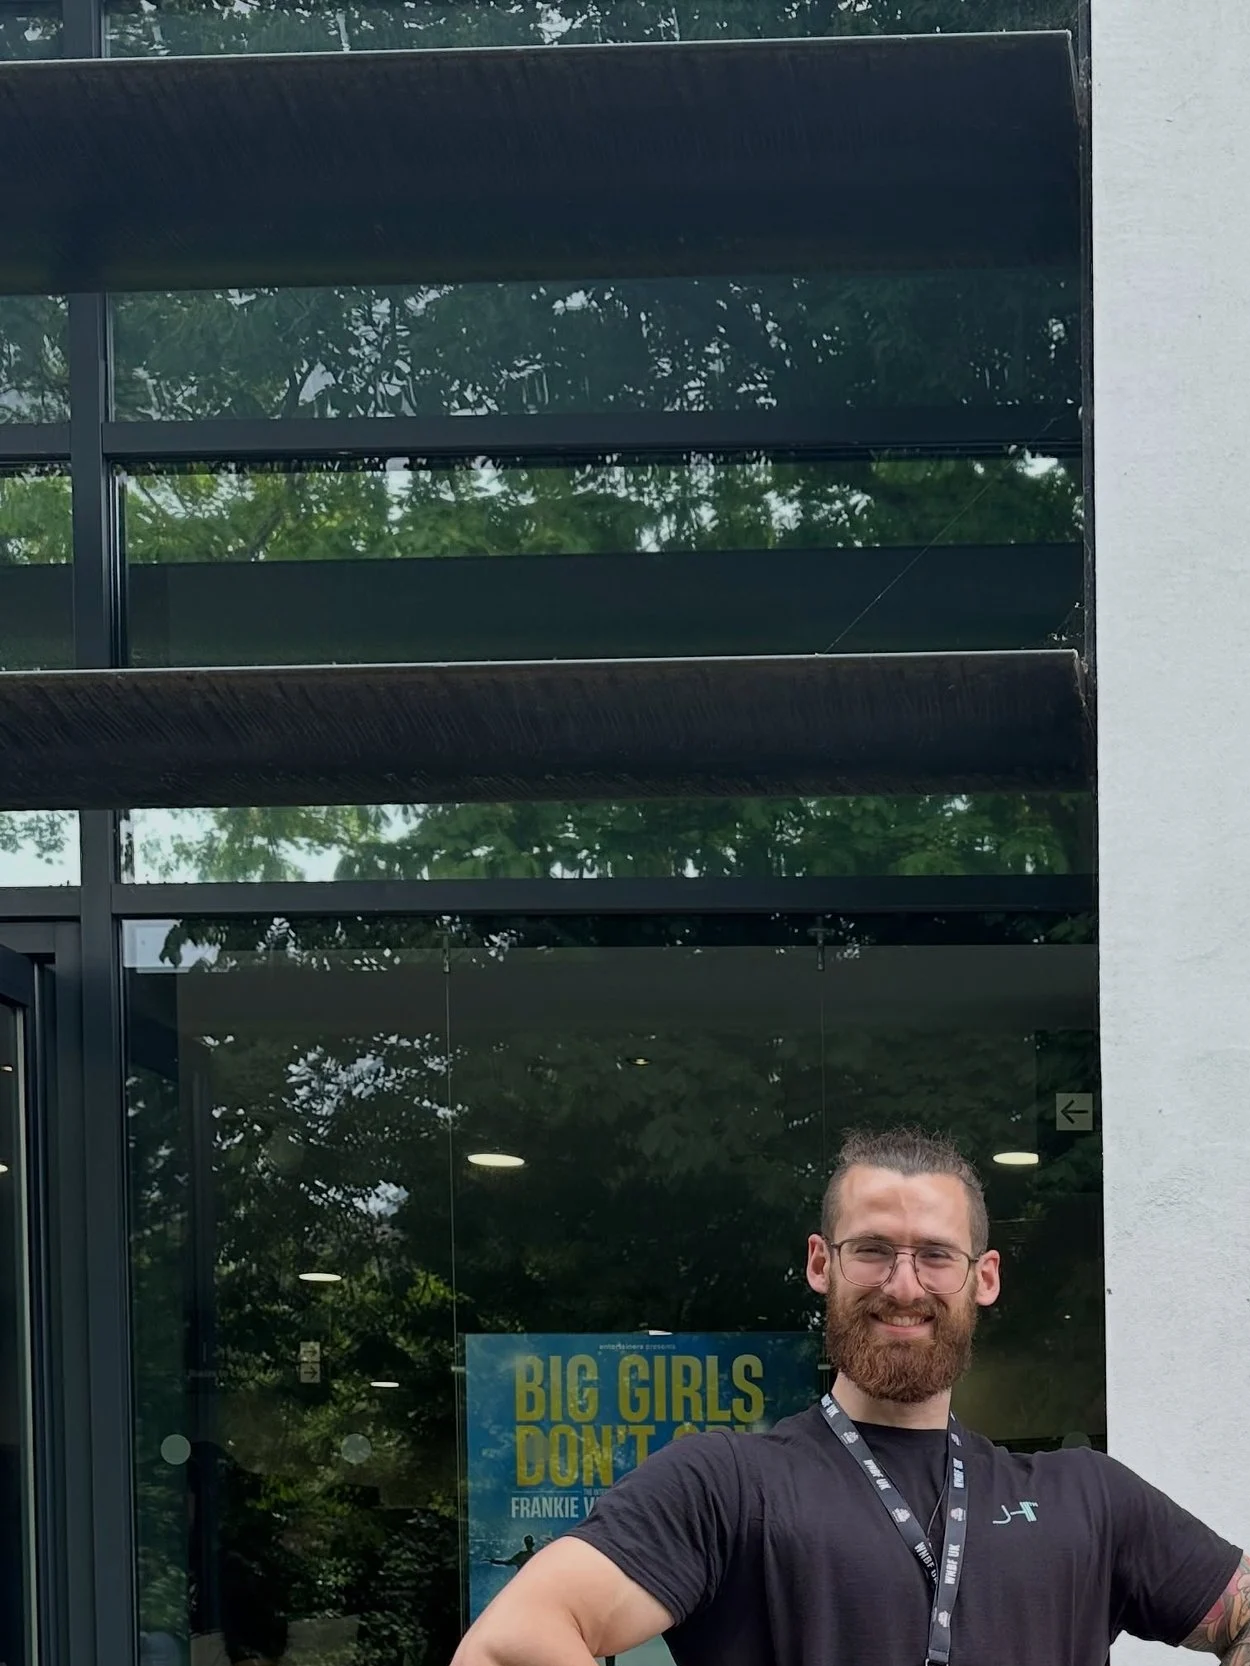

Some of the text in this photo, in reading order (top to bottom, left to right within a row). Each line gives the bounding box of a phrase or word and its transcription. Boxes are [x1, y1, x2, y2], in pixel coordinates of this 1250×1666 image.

[514, 1354, 765, 1423] BIG GIRLS
[515, 1424, 656, 1488] DON'T
[511, 1496, 579, 1519] FRANKIE
[914, 1541, 935, 1567] WNBF
[945, 1544, 960, 1585] WNBF UK
